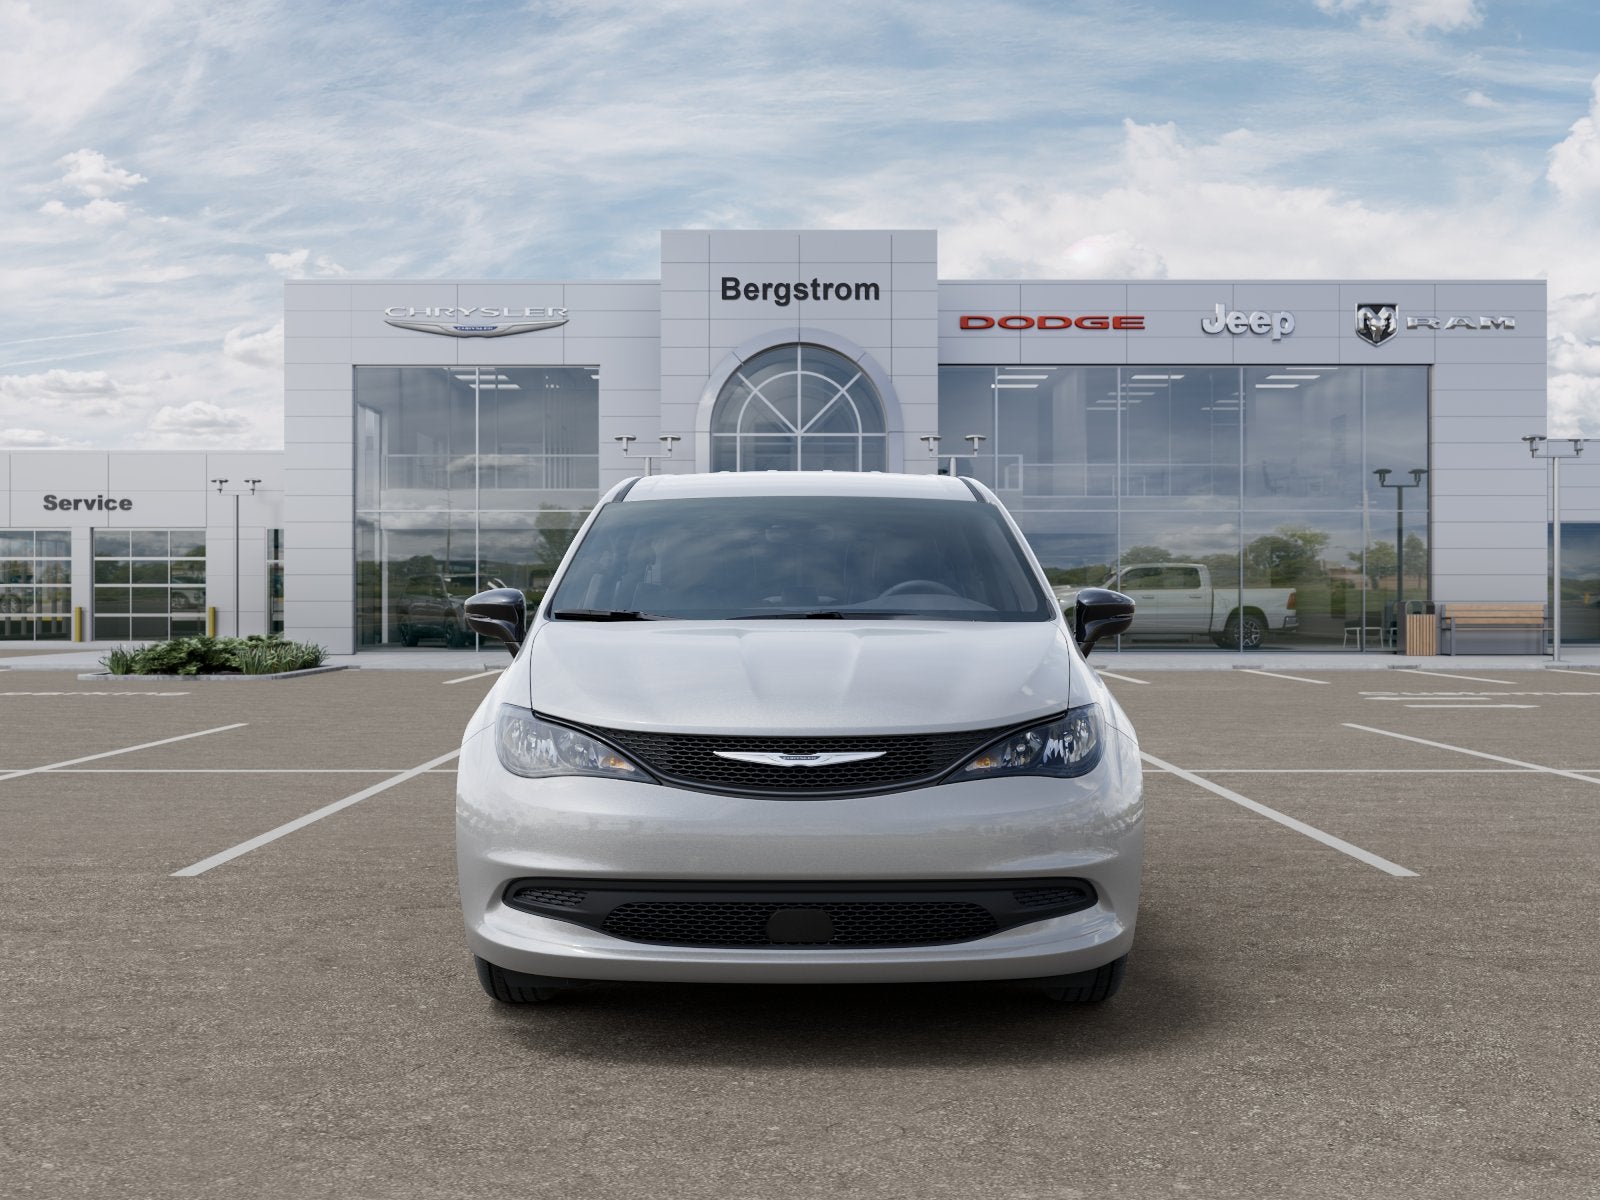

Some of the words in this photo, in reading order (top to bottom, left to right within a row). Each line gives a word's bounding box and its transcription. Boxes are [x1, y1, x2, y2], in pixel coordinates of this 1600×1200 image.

[721, 276, 880, 307] Bergstrom
[384, 306, 570, 318] CHRYSLER
[959, 315, 1146, 330] DODGE
[1201, 303, 1295, 342] Jeep
[1406, 316, 1516, 330] RAM
[43, 494, 133, 511] Service
